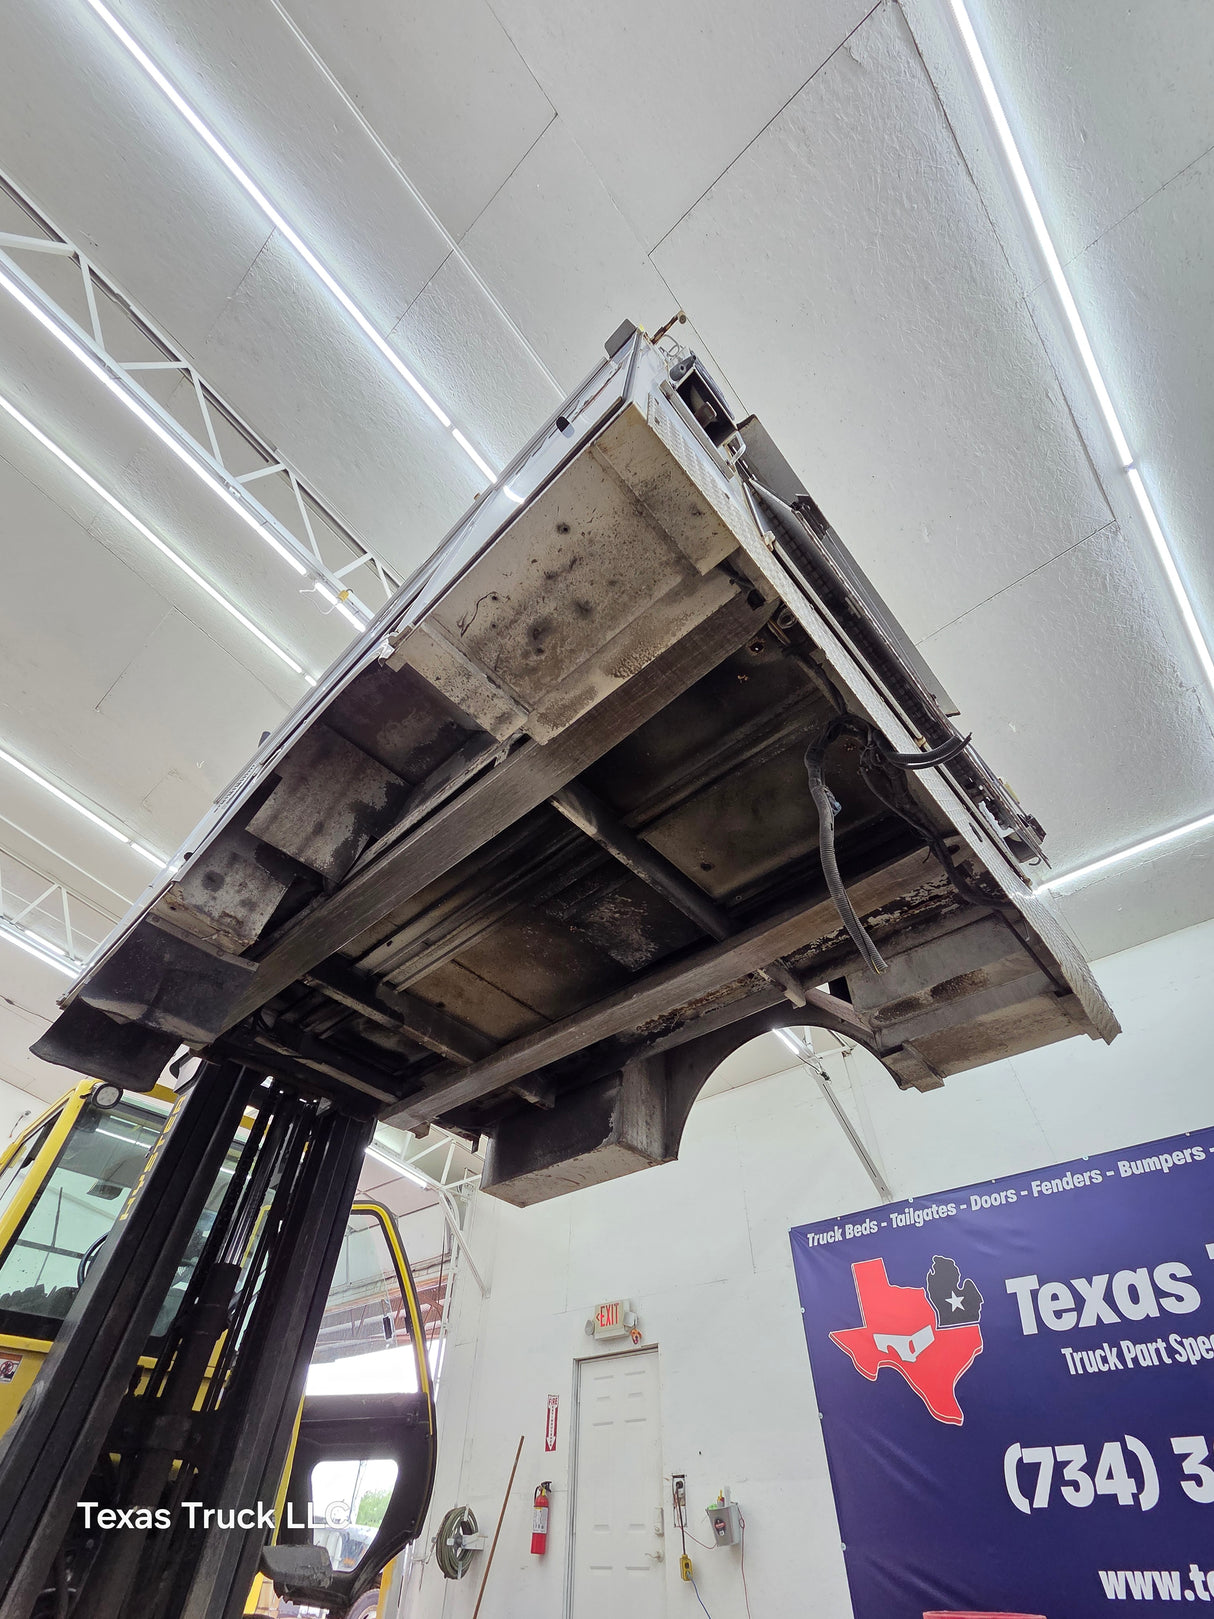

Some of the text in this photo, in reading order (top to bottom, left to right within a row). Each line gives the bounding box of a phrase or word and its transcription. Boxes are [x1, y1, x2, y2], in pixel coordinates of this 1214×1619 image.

[119, 1095, 187, 1221] HYSTER
[806, 1225, 844, 1248] Truck
[845, 1218, 879, 1240] Beds
[889, 1203, 957, 1229] Tailgates
[969, 1188, 1018, 1211] Doors
[1030, 1168, 1103, 1198] Fenders
[1117, 1145, 1207, 1179] Bumpers
[600, 1302, 620, 1327] EXIT
[1004, 1261, 1201, 1336] Texas
[1060, 1333, 1214, 1375] Truck Part Spe
[1003, 1434, 1214, 1515] (734) 3
